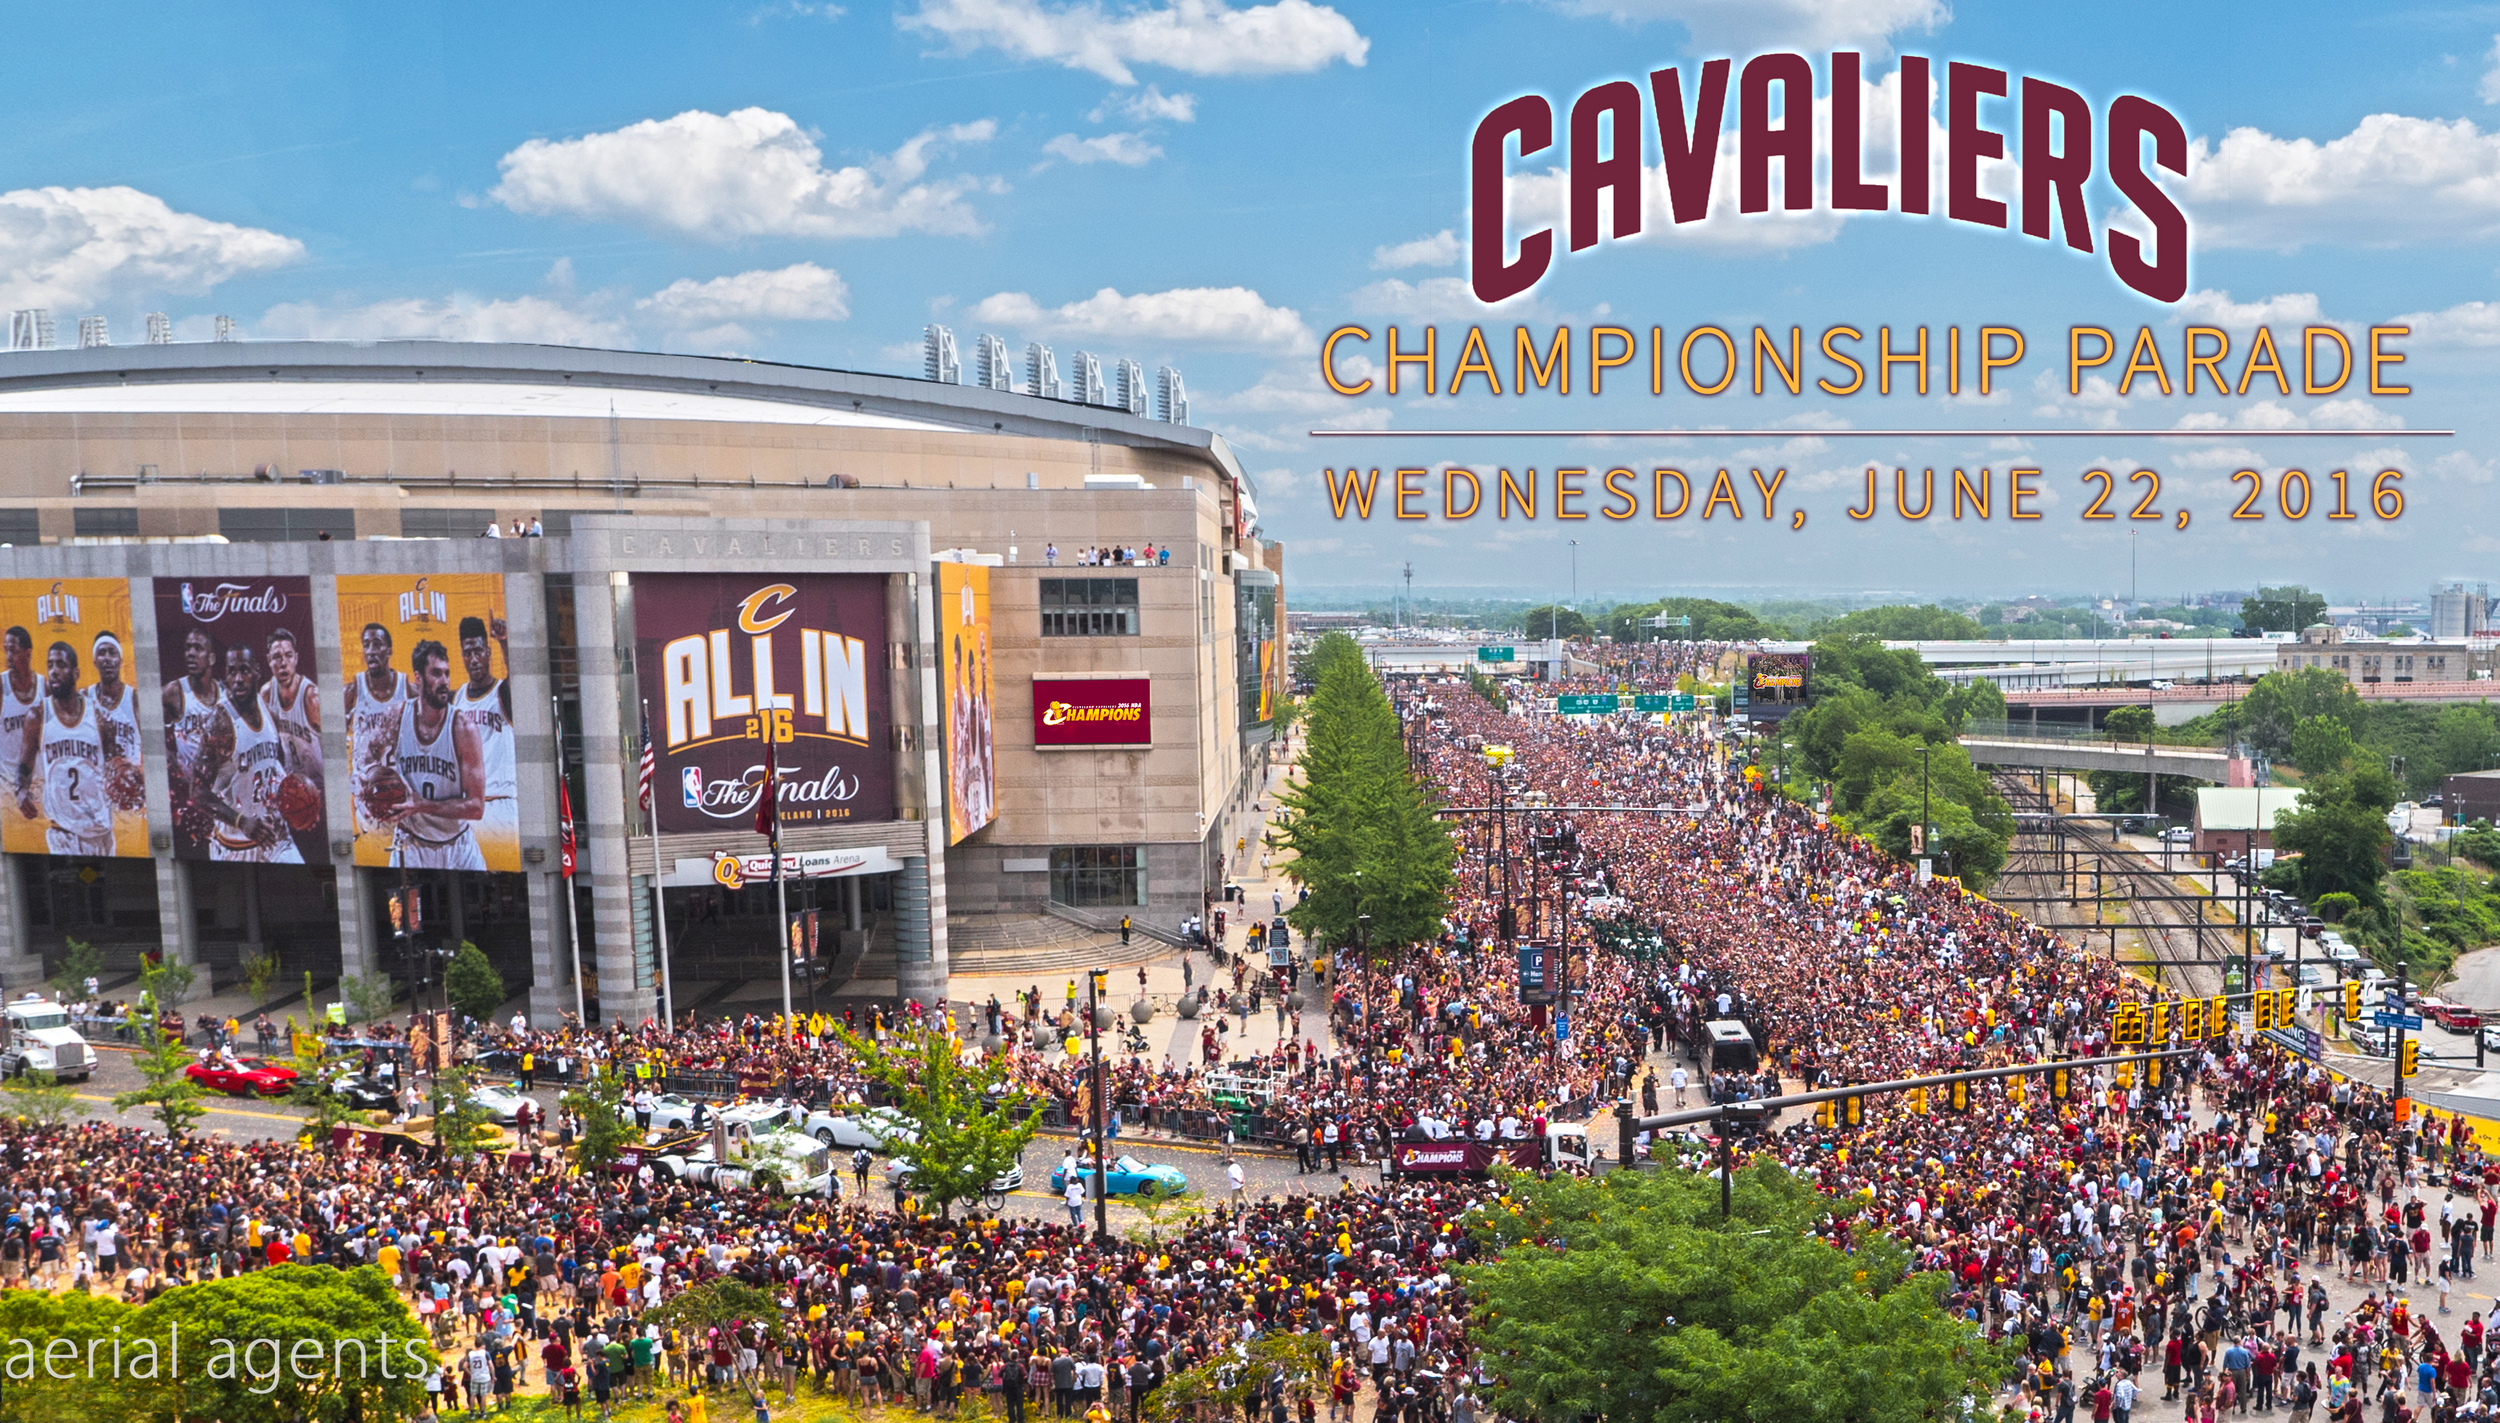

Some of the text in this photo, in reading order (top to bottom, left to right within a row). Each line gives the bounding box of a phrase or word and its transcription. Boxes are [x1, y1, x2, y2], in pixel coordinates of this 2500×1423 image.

[622, 536, 903, 556] CAVALIERS
[37, 594, 80, 624] ALL IN
[191, 583, 287, 622] The Finals
[399, 591, 447, 623] ALL IN
[663, 627, 869, 748] ALL IN
[1754, 672, 1803, 690] CHAMPIONS
[1043, 701, 1142, 725] CHAMPIONS
[745, 709, 795, 744] 216
[45, 739, 99, 766] CAVALIERS
[400, 755, 457, 782] CAVALIERS
[68, 767, 80, 801] 2
[699, 765, 860, 819] The Fnals
[825, 808, 850, 818] 2016
[714, 856, 746, 890] Q
[749, 853, 861, 873] Quicen Loans Arena
[1535, 956, 1543, 966] P
[2386, 994, 2406, 1011] Ontario
[2376, 1018, 2404, 1028] W Huron
[2402, 1015, 2420, 1024] Huron
[1402, 1149, 1464, 1166] CHAMPIONS
[472, 1359, 483, 1370] 23
